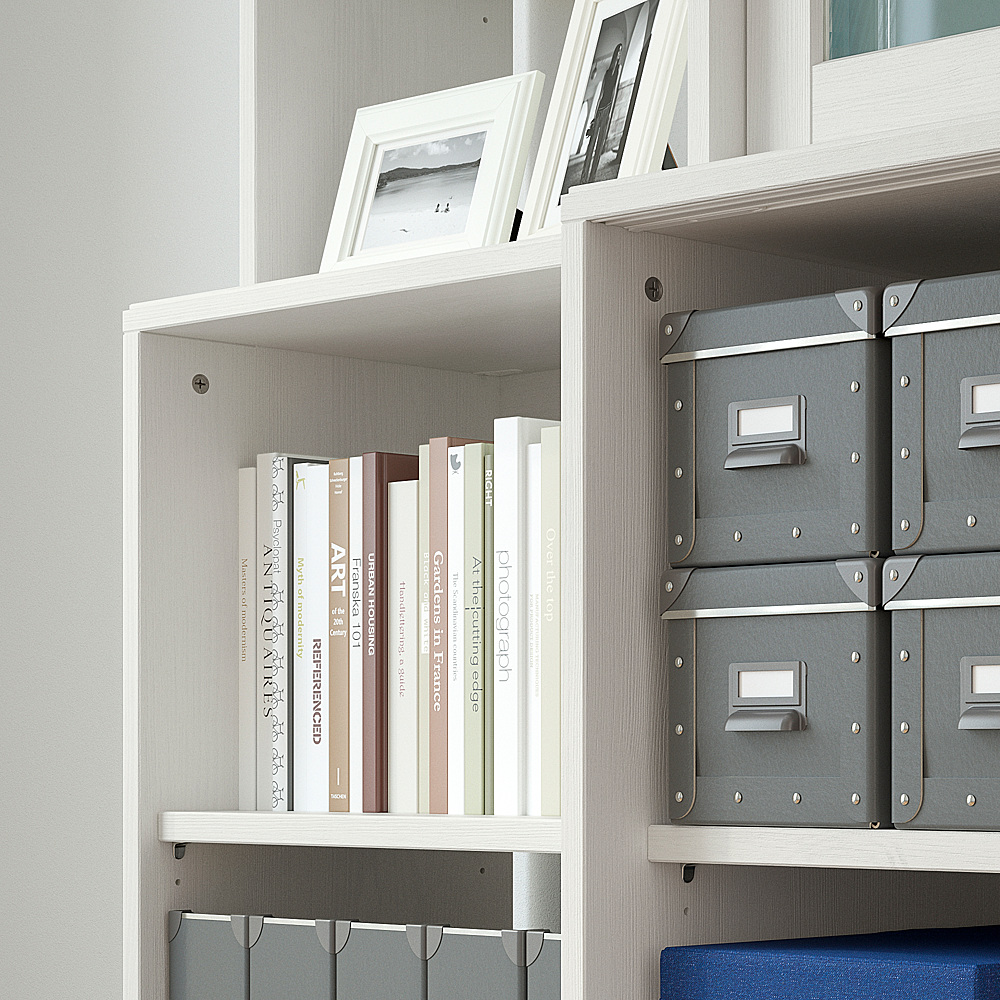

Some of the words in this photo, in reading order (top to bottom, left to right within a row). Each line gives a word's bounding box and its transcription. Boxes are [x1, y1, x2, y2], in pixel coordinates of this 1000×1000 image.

[485, 469, 493, 507] RIGHT
[472, 557, 482, 575] At
[546, 528, 556, 566] Over
[296, 557, 305, 585] Myth
[331, 542, 346, 597] ART
[352, 558, 361, 617] Franska
[433, 551, 443, 624] Gardens
[546, 570, 556, 593] the
[241, 601, 248, 611] of
[297, 588, 305, 600] of
[472, 580, 482, 605] the
[544, 598, 556, 622] top
[261, 544, 273, 718] ANTIQUAIRES
[296, 603, 305, 659] modernity
[496, 550, 512, 682] photograph
[352, 623, 361, 649] 101
[433, 629, 444, 646] in
[470, 611, 482, 666] cutting
[313, 639, 321, 745] REFERENCED
[398, 669, 407, 697] guide
[433, 651, 443, 712] France
[470, 671, 482, 713] edge
